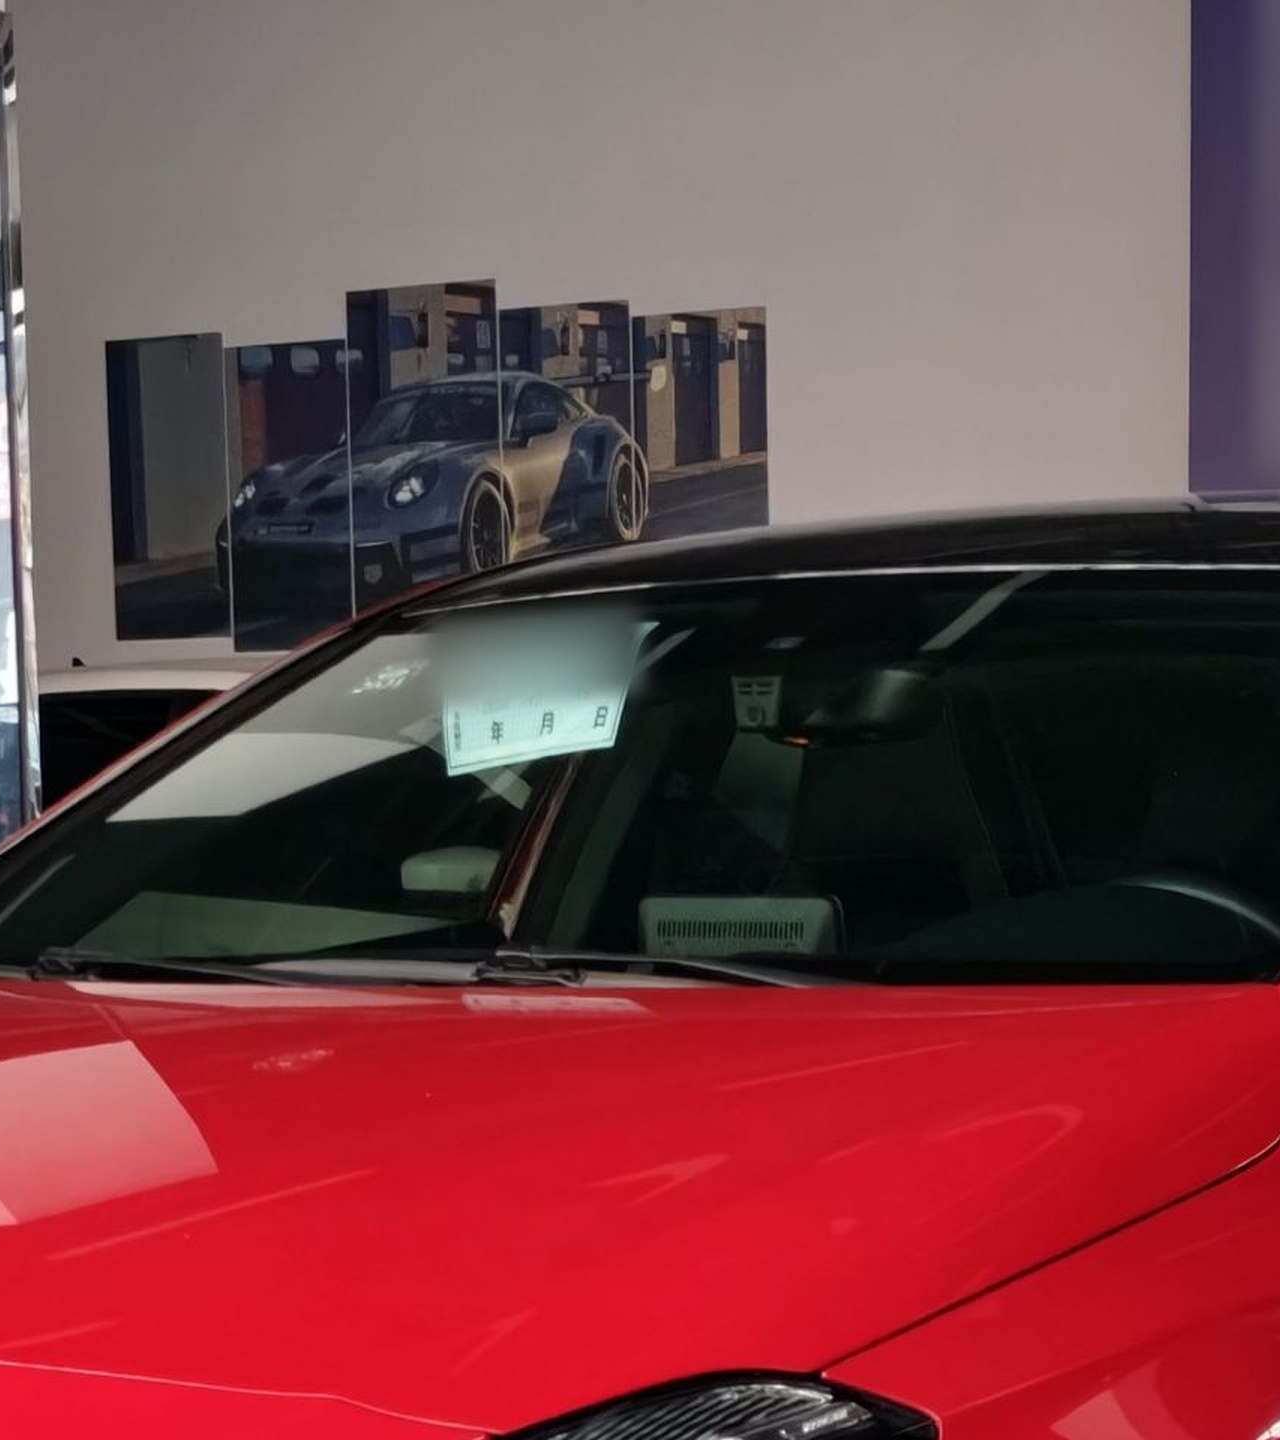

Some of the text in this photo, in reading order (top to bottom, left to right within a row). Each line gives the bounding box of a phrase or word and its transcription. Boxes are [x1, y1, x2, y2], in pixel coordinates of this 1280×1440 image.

[491, 719, 504, 744] 年
[540, 711, 554, 736] 月
[593, 705, 609, 729] 日
